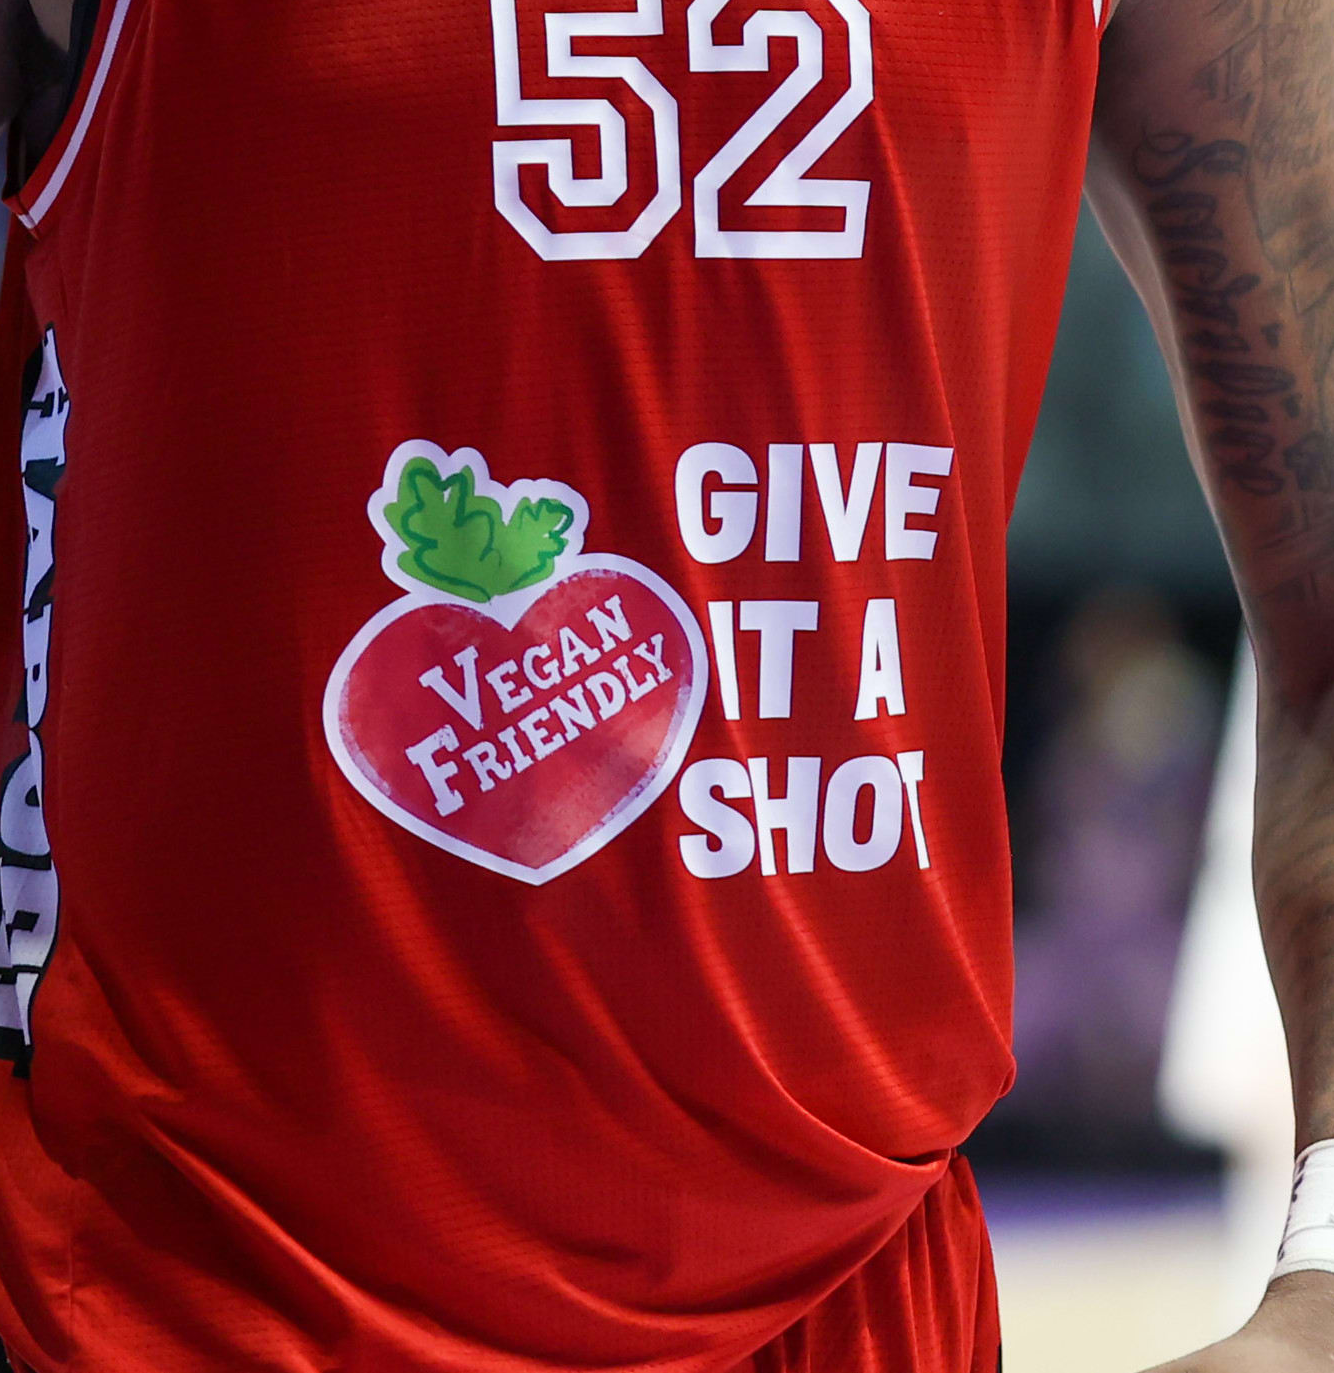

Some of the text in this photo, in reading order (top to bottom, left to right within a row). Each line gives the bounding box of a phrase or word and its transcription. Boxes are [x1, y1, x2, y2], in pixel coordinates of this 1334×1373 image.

[674, 441, 954, 565] GIVE
[419, 594, 634, 731] VEGAN
[707, 598, 907, 721] IT A
[405, 633, 676, 818] FRIENDLY
[677, 749, 931, 879] SHOT
